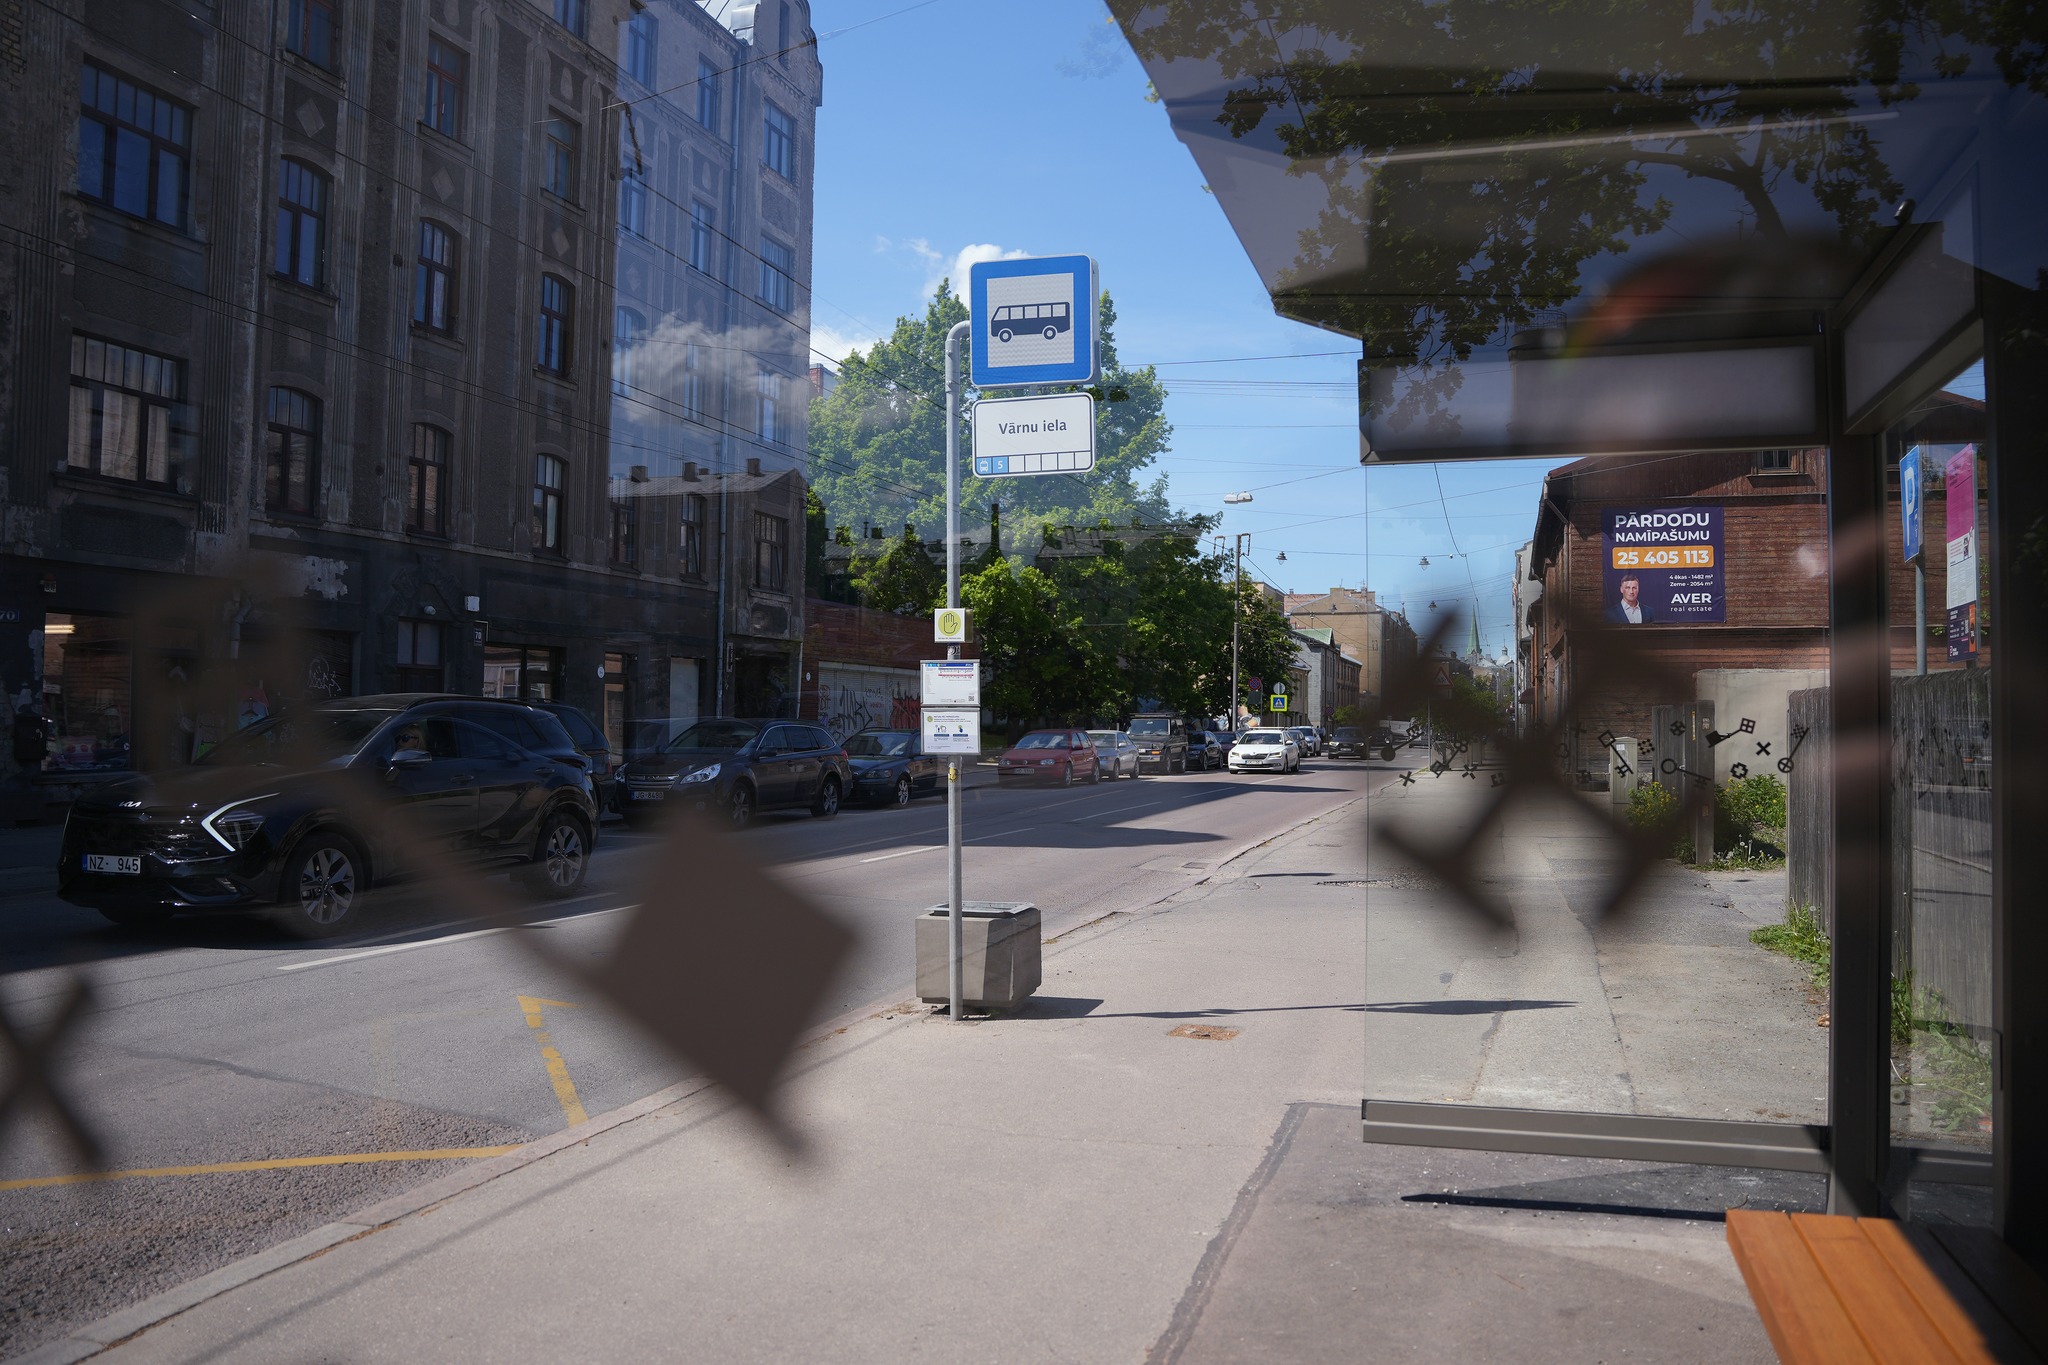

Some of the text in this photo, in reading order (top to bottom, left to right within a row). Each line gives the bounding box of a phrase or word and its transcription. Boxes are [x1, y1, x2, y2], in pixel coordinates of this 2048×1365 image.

[998, 419, 1067, 435] Vārnu iela
[997, 461, 1003, 470] 5
[1904, 466, 1916, 547] P
[1615, 512, 1710, 528] PĀRDODU
[1615, 529, 1710, 543] NAMĪPAŠUMU
[1617, 550, 1710, 565] 25 405 113
[1671, 593, 1712, 604] AVER
[117, 857, 139, 872] 945
